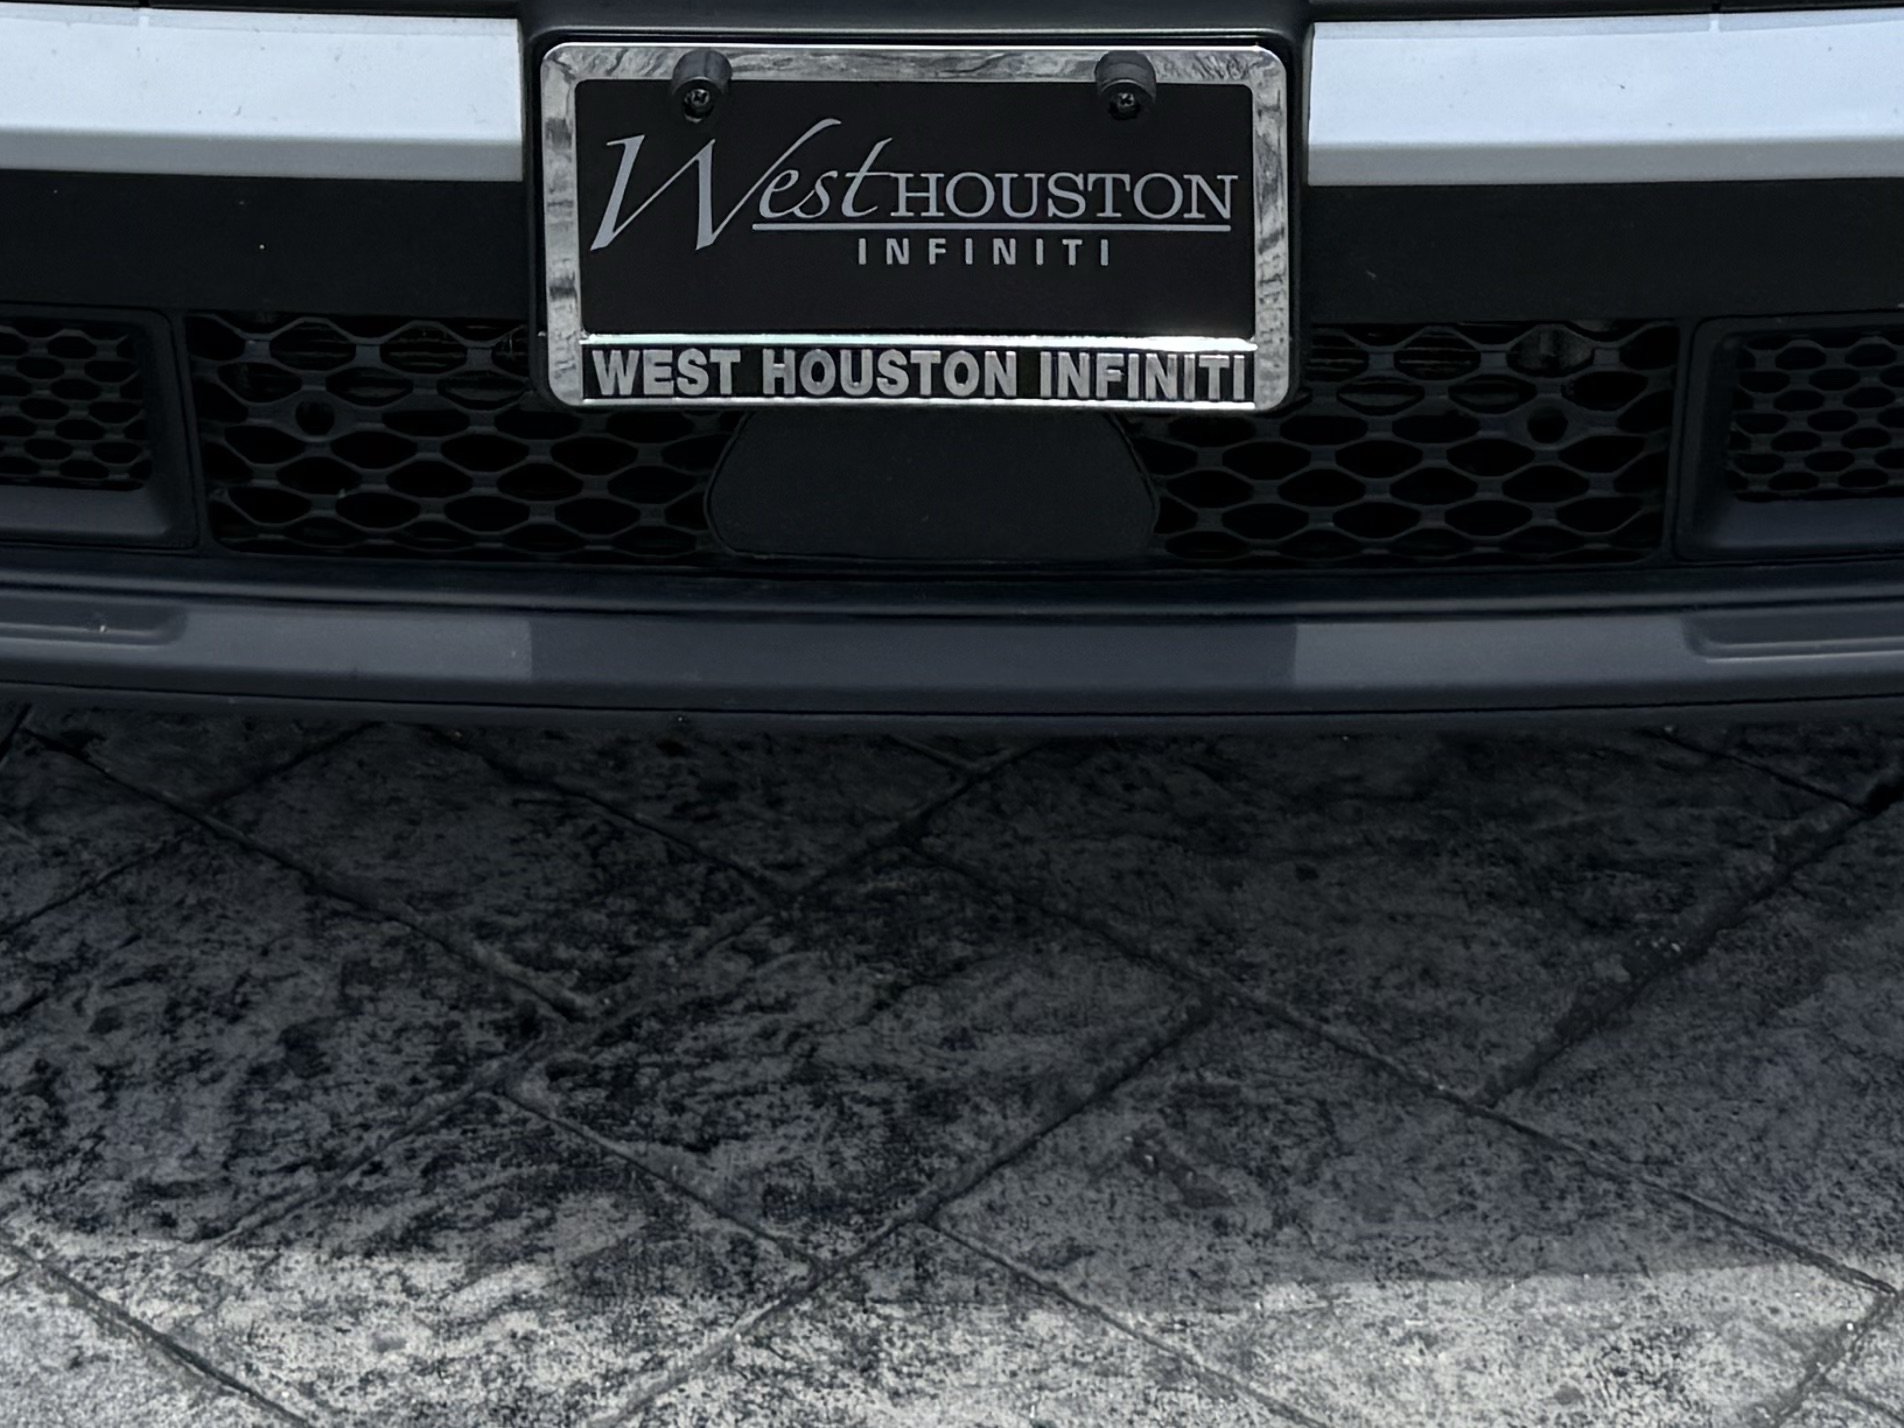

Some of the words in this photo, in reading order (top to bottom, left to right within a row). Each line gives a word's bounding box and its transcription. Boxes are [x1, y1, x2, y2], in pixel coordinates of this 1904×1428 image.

[858, 237, 1110, 266] INFINITI
[592, 349, 742, 396] WEST
[763, 350, 1017, 398] HOUSTON
[1040, 352, 1246, 401] INFINITI
